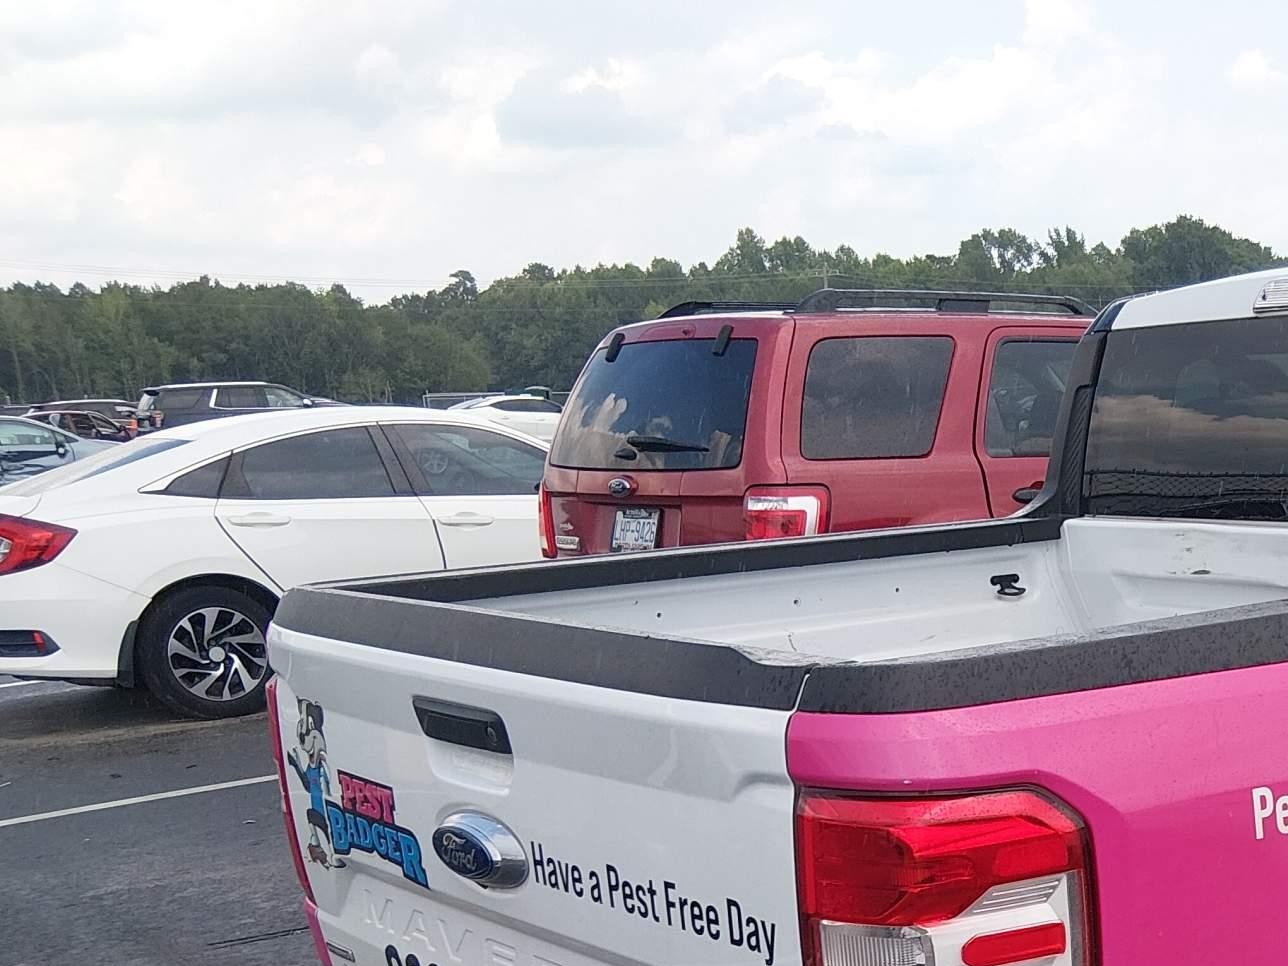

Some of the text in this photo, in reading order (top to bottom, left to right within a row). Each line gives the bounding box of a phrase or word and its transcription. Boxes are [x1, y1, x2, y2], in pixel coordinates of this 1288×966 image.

[613, 519, 656, 543] LHP-9426
[338, 774, 394, 824] PEST
[327, 805, 427, 886] BADGER
[441, 832, 478, 871] Ford
[531, 841, 777, 966] Have a Pest Free Day
